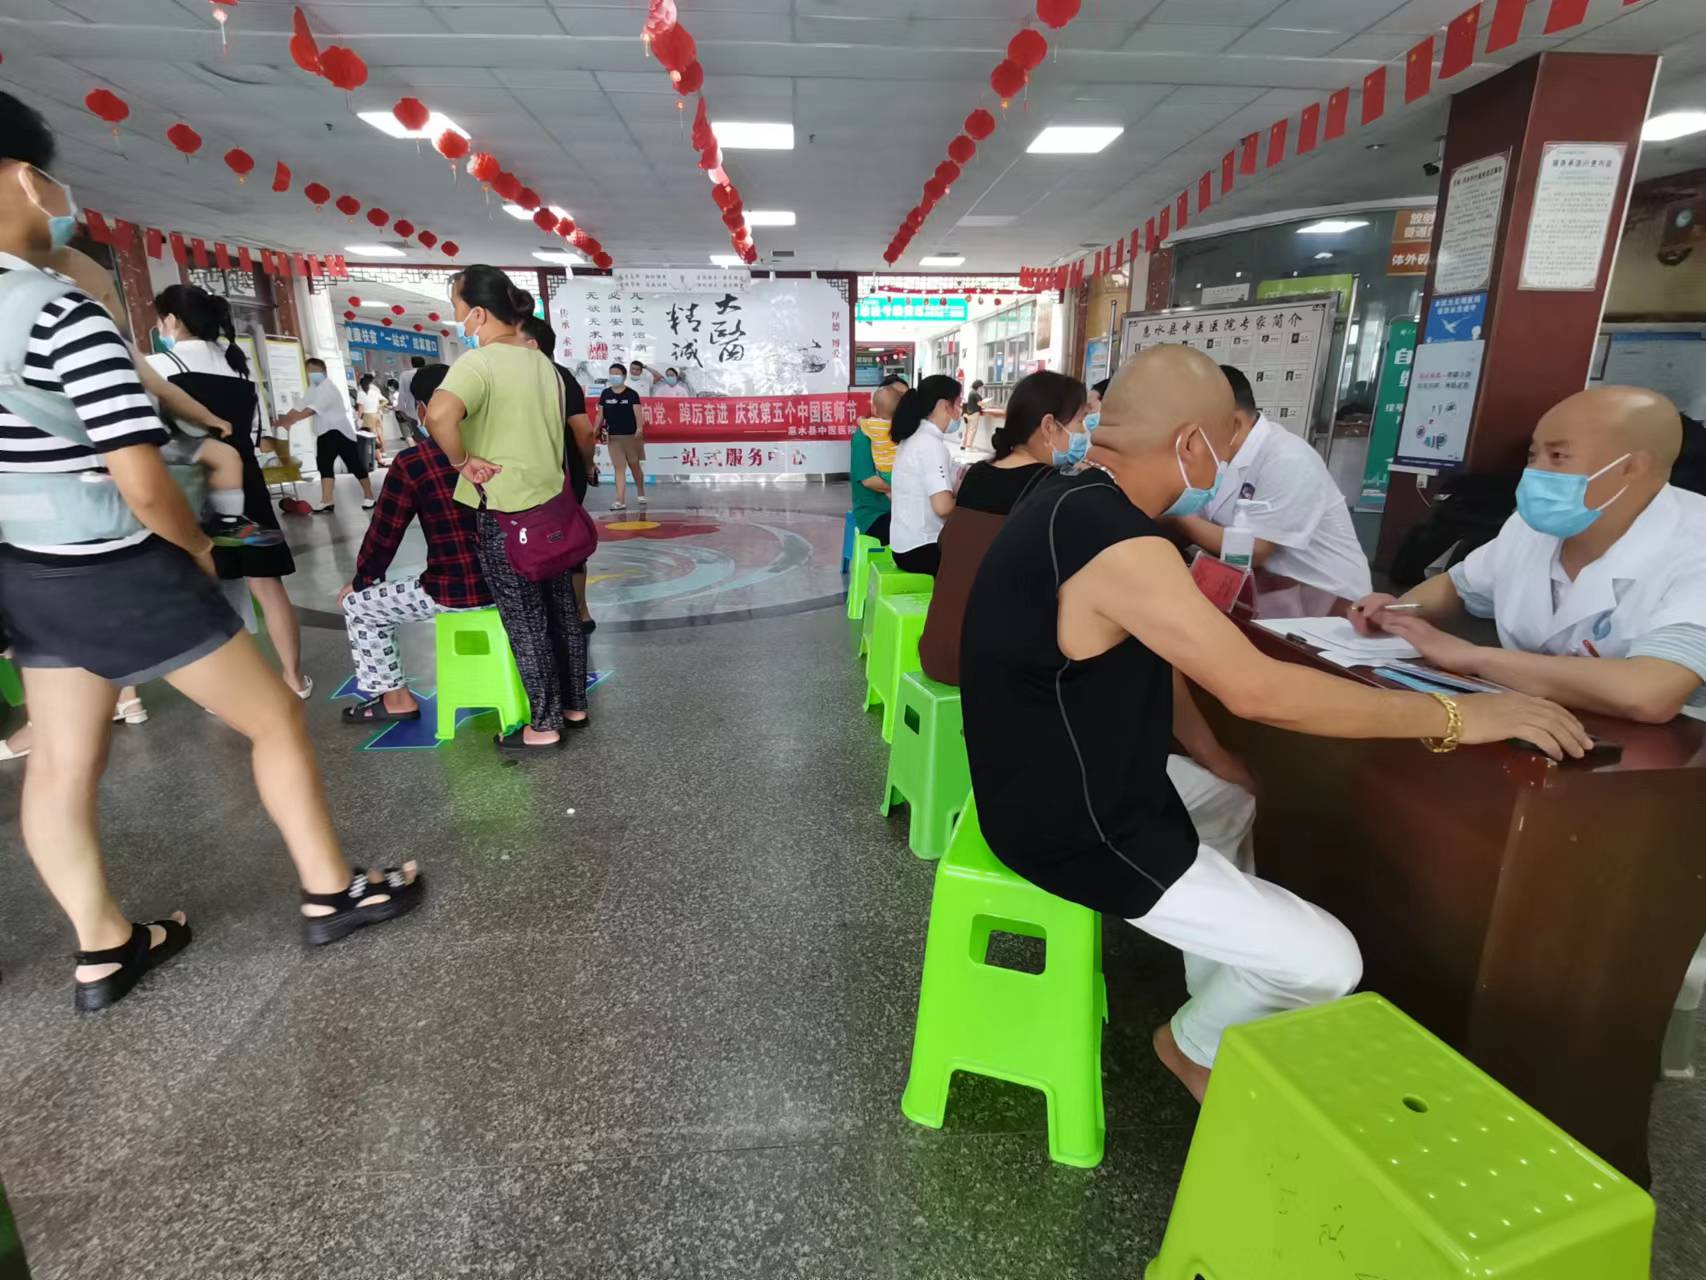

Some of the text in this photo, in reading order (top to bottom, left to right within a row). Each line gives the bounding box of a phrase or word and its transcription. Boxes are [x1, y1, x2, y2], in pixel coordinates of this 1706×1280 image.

[735, 399, 858, 426] 庆祝第五个中国医师节
